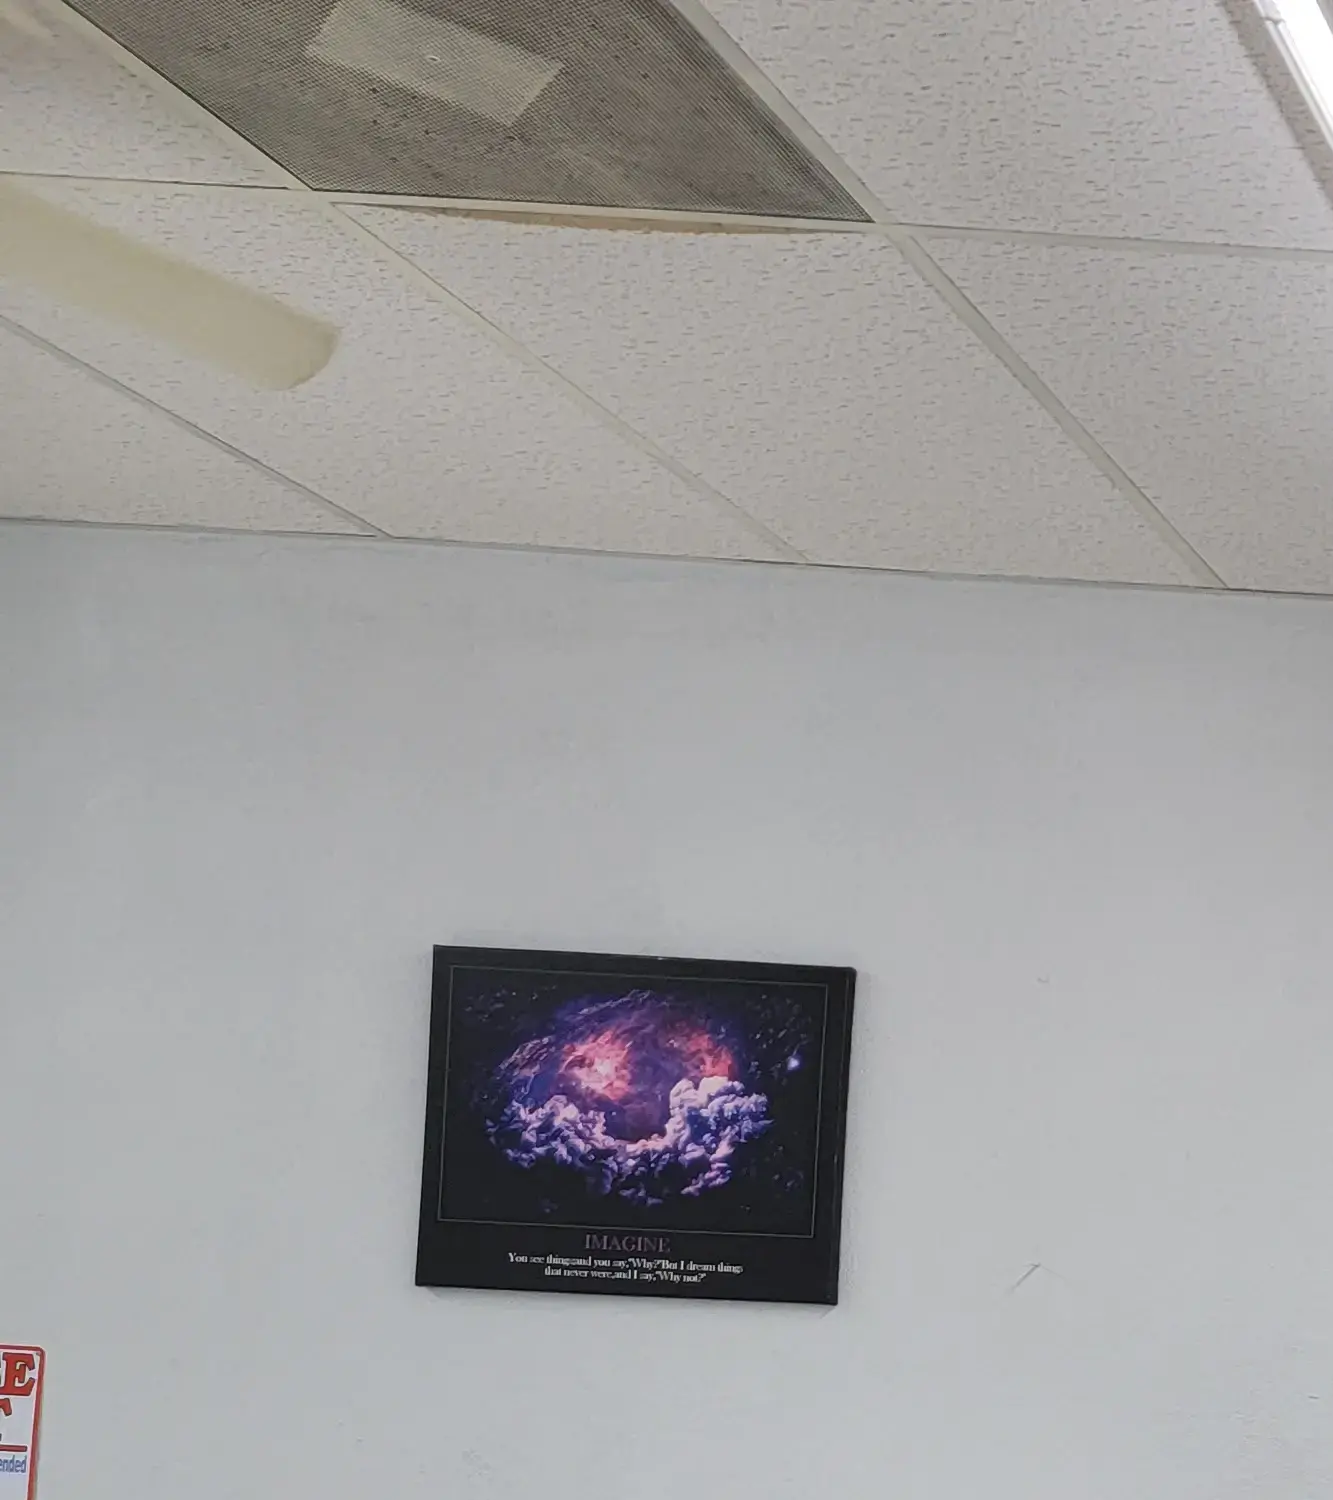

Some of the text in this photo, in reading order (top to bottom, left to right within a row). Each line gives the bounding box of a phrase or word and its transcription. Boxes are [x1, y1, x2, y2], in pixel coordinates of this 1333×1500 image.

[585, 1234, 671, 1253] IMAGINE
[508, 1252, 528, 1263] You
[593, 1258, 610, 1269] you
[686, 1261, 715, 1272] dream
[545, 1265, 561, 1276] that
[563, 1268, 589, 1278] never
